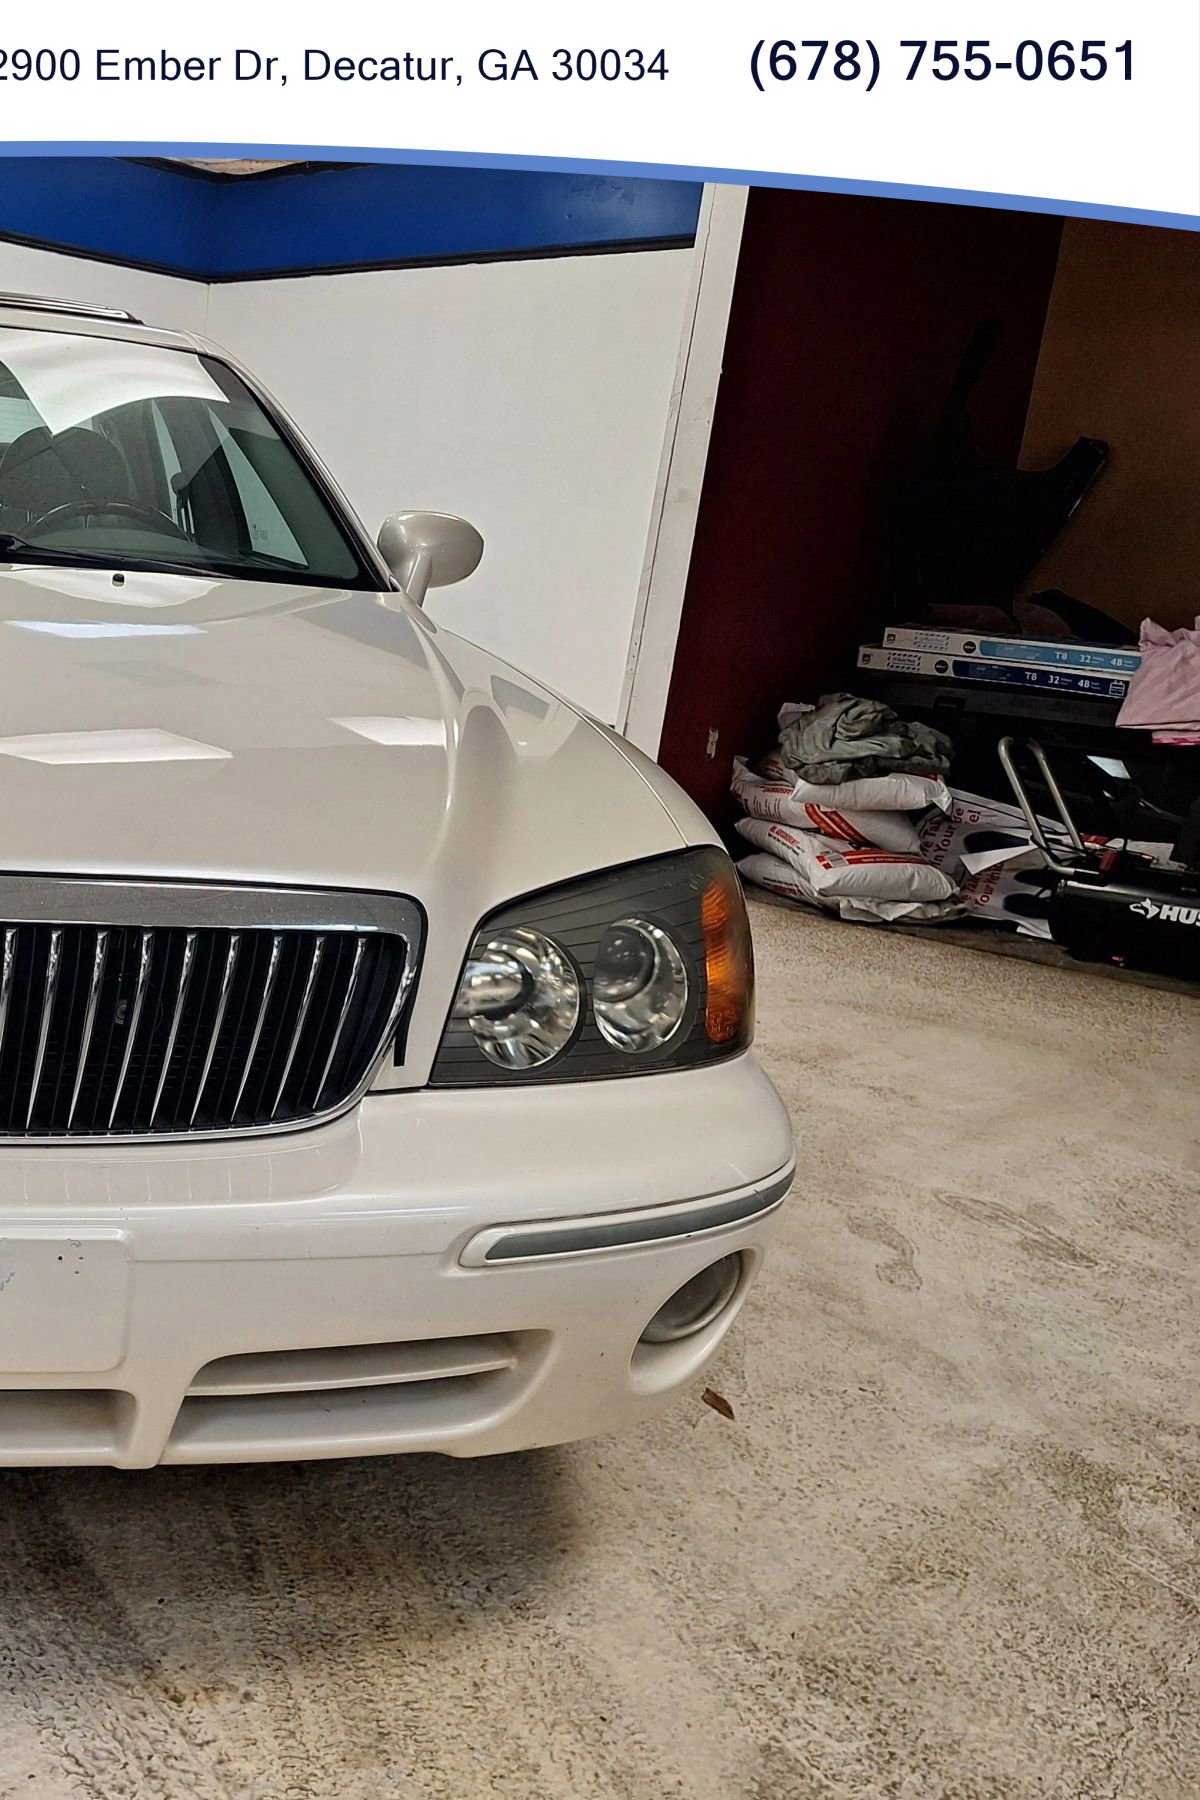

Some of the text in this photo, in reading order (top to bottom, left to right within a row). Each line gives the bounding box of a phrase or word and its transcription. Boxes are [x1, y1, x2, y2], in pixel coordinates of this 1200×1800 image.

[1054, 651, 1068, 661] T8
[1080, 654, 1091, 664] 32
[1109, 657, 1123, 667] 48
[1024, 671, 1038, 681] T8
[1048, 674, 1060, 685] 32
[1077, 679, 1090, 688] 48
[933, 825, 957, 853] Your
